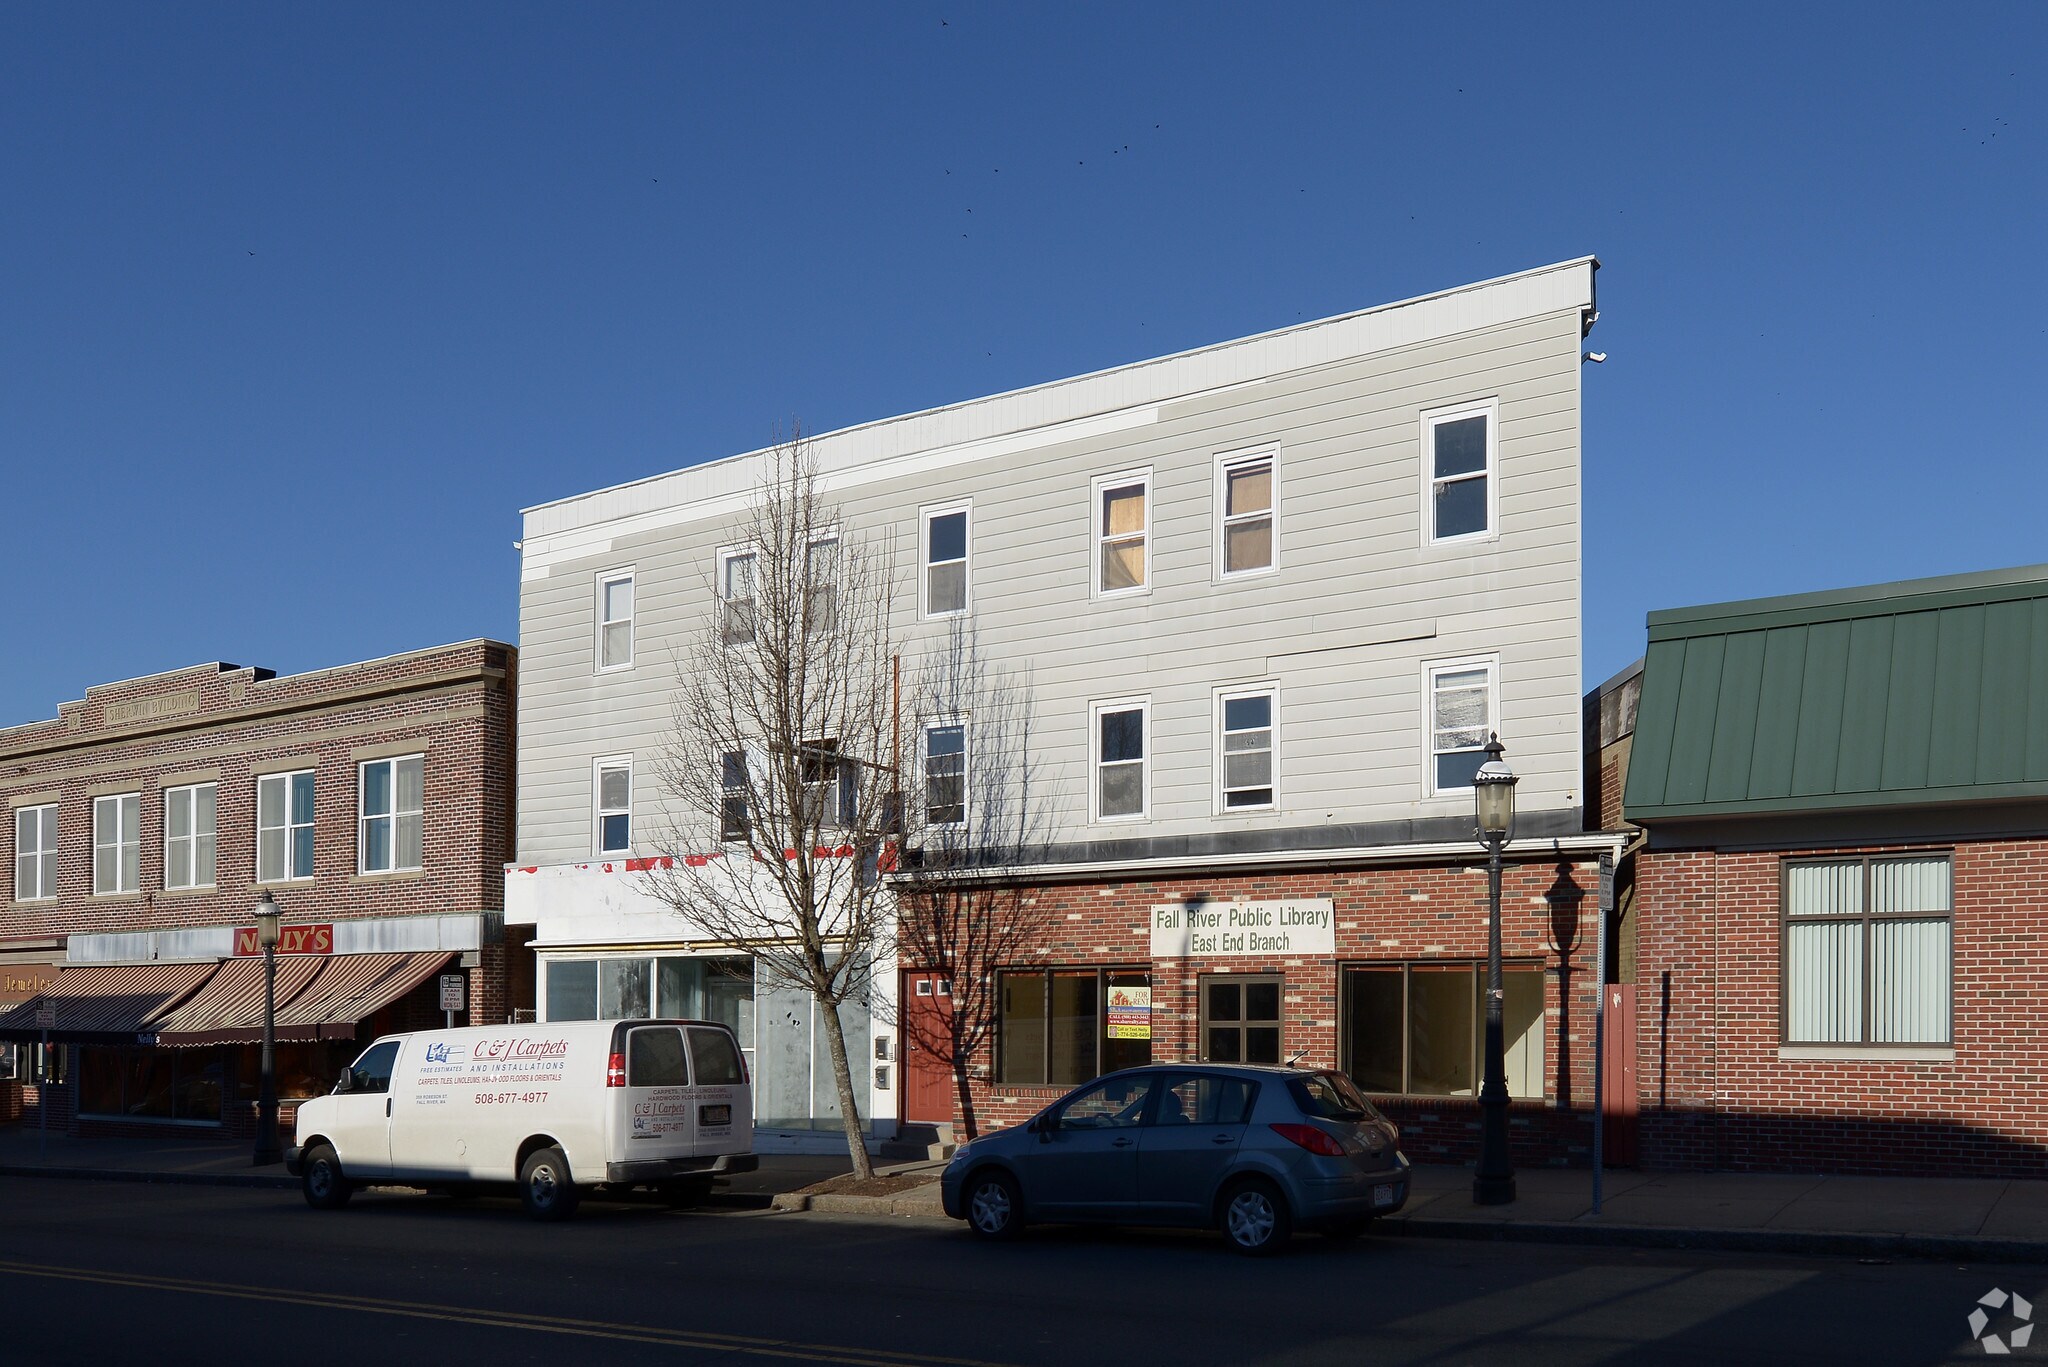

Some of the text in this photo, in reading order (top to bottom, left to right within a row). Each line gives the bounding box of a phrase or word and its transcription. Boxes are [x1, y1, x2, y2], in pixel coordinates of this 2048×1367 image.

[109, 706, 149, 722] SHERWIN
[69, 716, 78, 727] 19
[1156, 906, 1329, 929] Fall River Public Library
[236, 926, 330, 953] NLY'S
[1192, 932, 1290, 952] East End Branch
[136, 1033, 160, 1046] Nelly's
[474, 1038, 568, 1062] C & J Carpets
[492, 1062, 564, 1071] INSTALLATIONS
[475, 1092, 548, 1104] 508-677-4977
[635, 1103, 685, 1117] C & J Carpets
[652, 1123, 684, 1133] 508-677-4977
